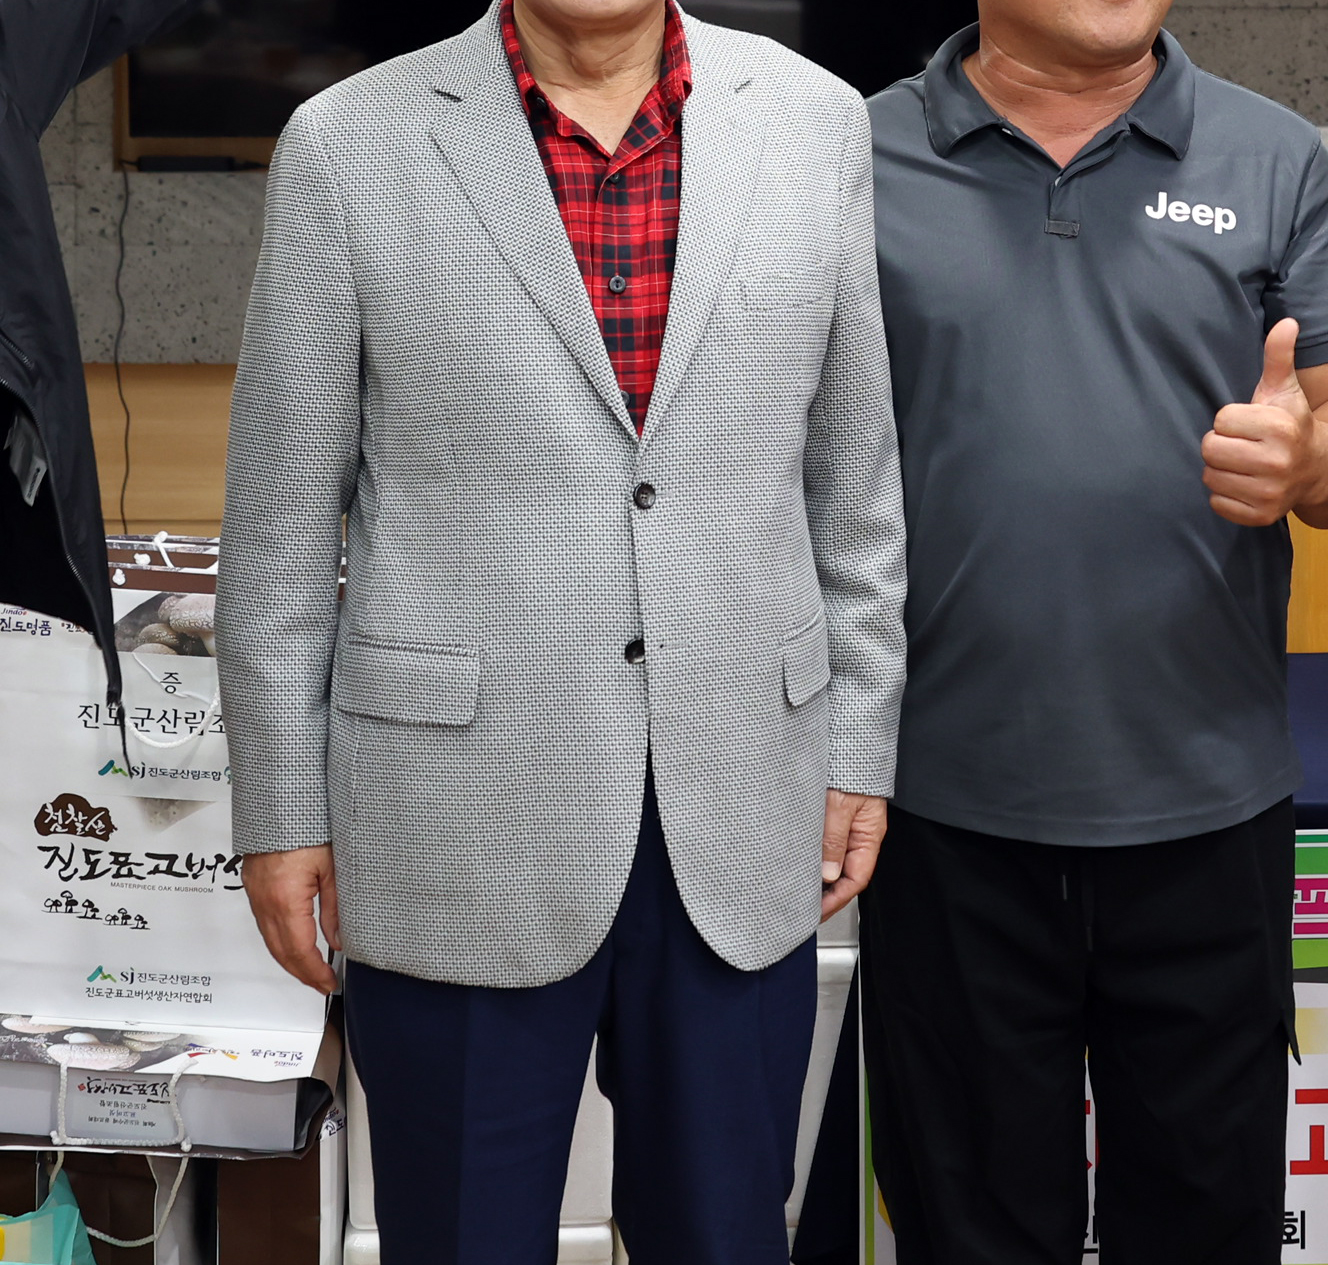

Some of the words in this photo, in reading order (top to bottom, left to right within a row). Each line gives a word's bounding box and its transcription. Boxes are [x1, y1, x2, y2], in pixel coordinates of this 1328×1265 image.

[1145, 191, 1238, 235] Jeep
[160, 671, 183, 694] 증
[147, 766, 222, 781] 진도군산림조합
[110, 881, 156, 891] MASTERPIECE
[174, 886, 214, 894] MUSHROOM
[120, 966, 135, 984] sj
[137, 971, 212, 986] 진도군산림조합
[85, 986, 213, 1004] 진도군표고버섯생산자연합회
